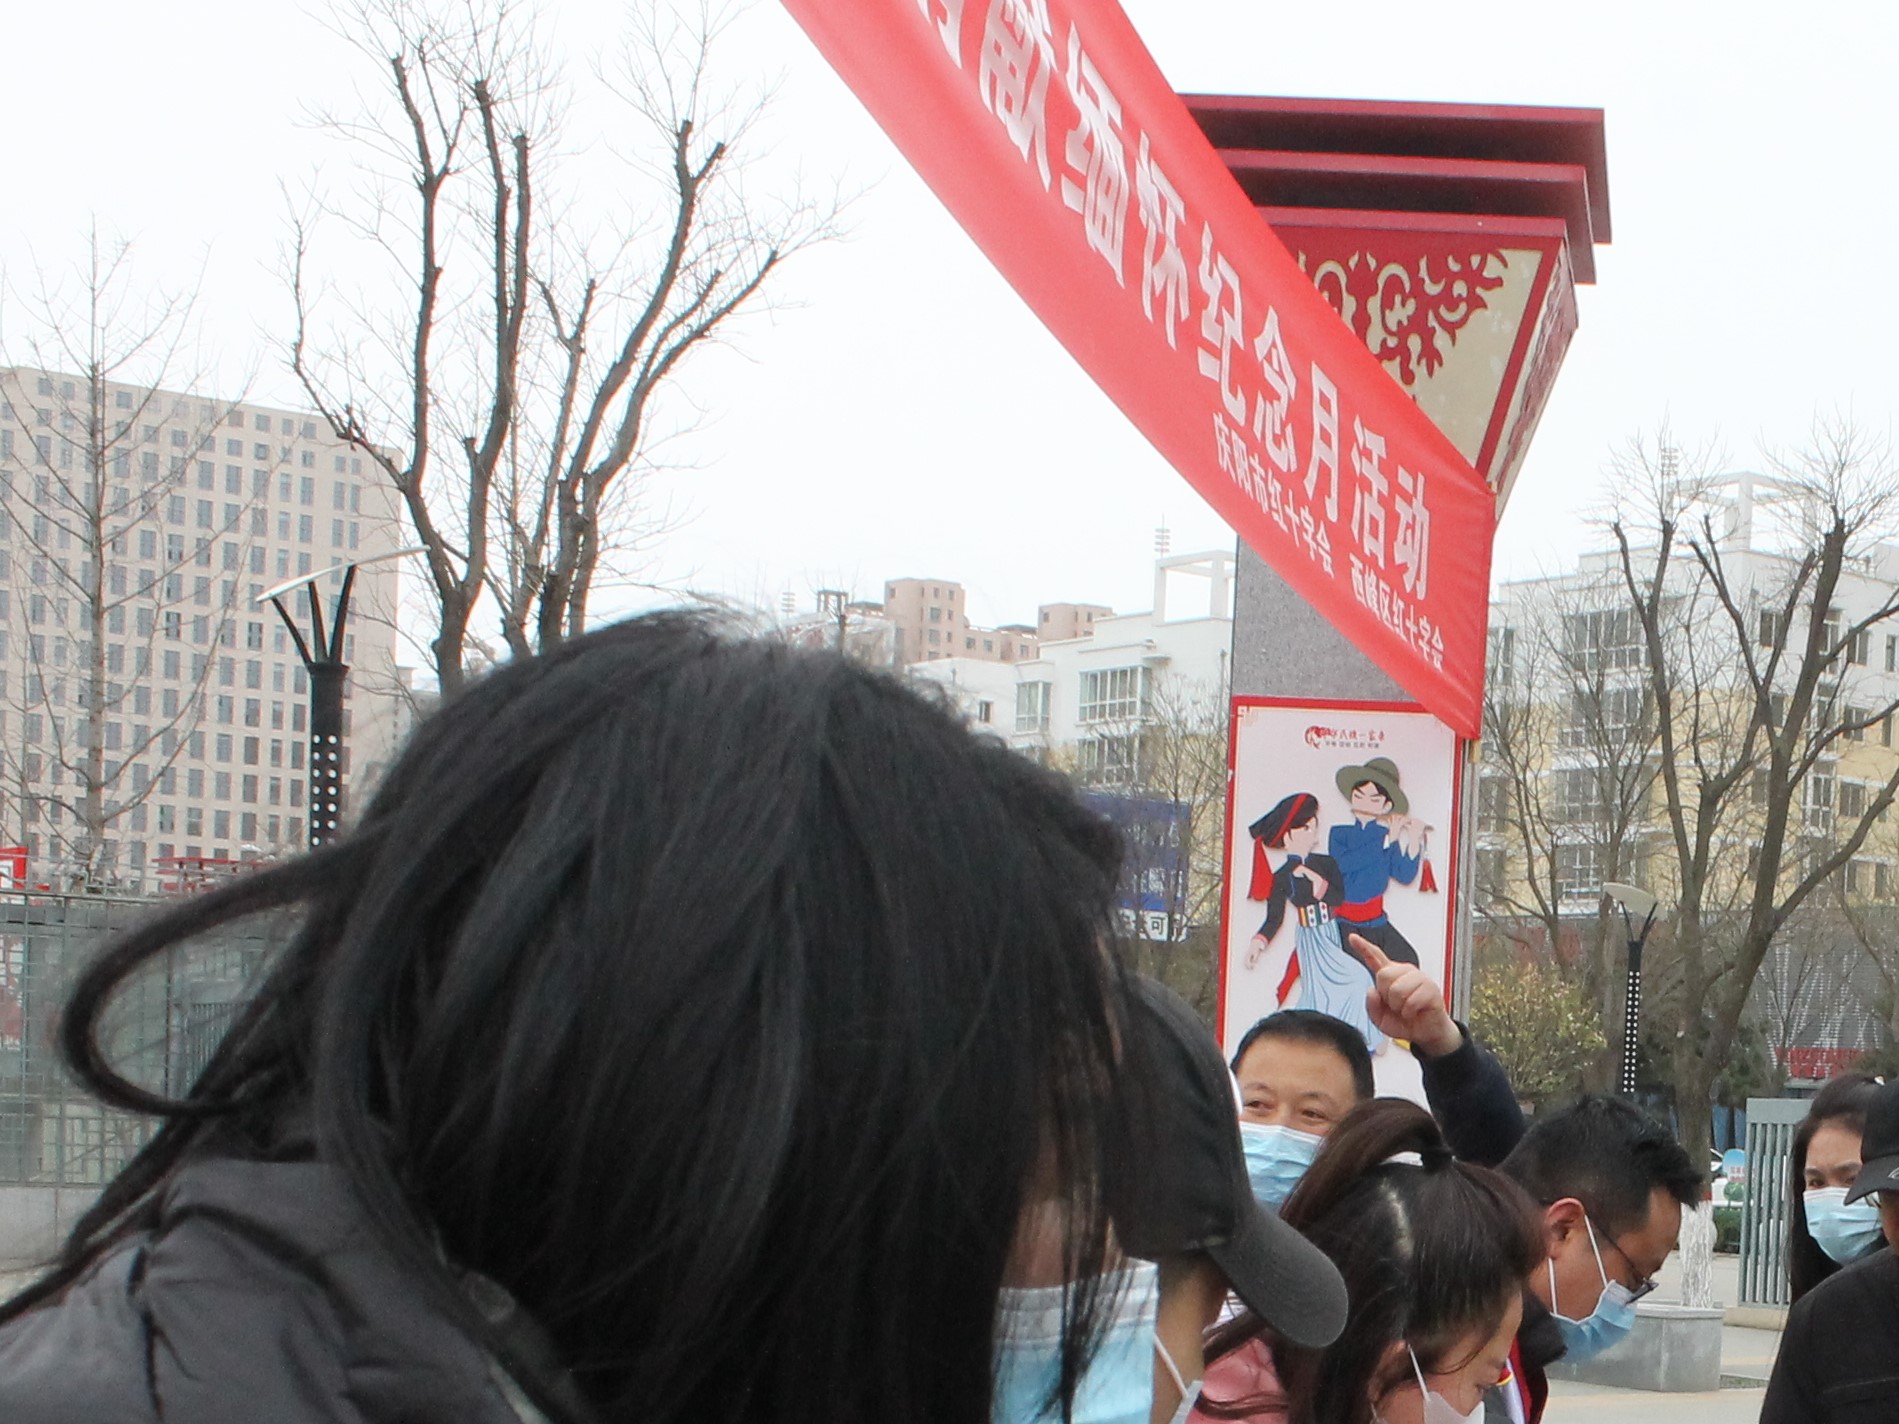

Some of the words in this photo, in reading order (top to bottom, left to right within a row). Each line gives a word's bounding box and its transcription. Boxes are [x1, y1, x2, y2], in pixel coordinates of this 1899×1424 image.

[914, 0, 1430, 600] 献缅怀纪念月活动
[1213, 412, 1334, 579] 庆阳市红十字会
[1350, 552, 1445, 672] 西峰区红十字会
